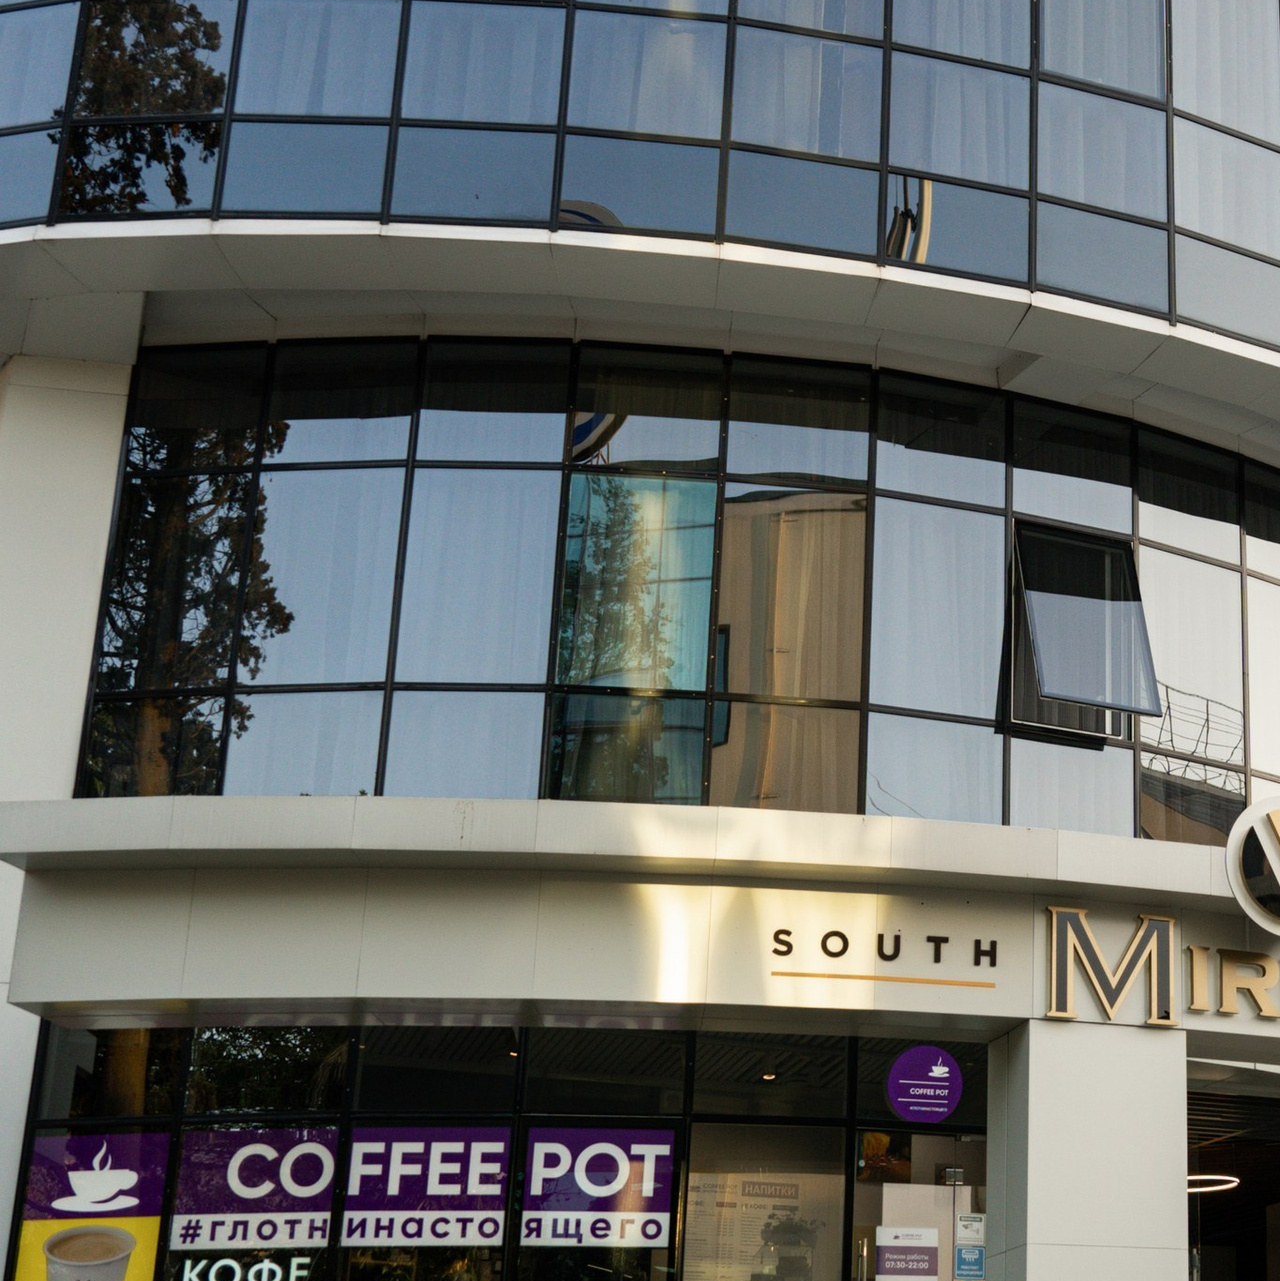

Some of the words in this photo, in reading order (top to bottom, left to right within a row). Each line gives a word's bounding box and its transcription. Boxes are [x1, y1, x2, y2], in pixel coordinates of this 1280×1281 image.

[772, 929, 998, 967] SOUTH
[910, 1087, 934, 1096] COFFEE
[936, 1089, 949, 1097] POT
[226, 1141, 505, 1198] COFFEE
[530, 1142, 672, 1198] POT
[745, 1184, 795, 1197] НАПИТКИ
[907, 1252, 929, 1262] работы
[885, 1261, 929, 1269] 07:30-22:00
